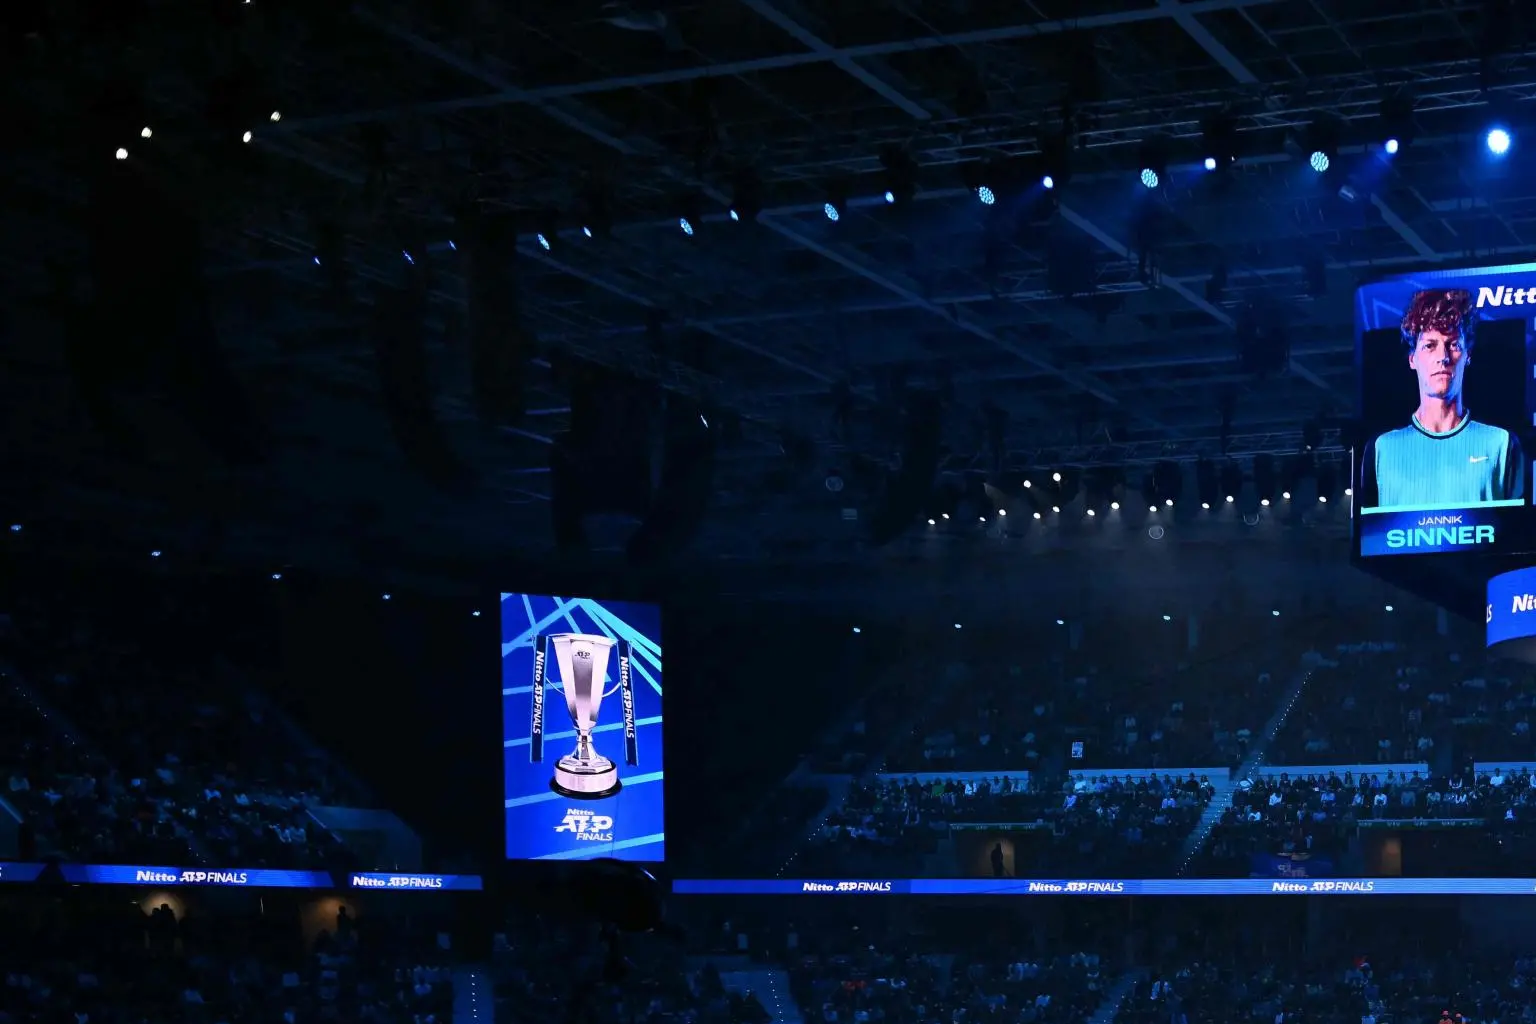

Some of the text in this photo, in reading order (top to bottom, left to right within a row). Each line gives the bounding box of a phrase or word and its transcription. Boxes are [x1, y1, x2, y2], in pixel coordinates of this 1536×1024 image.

[1418, 516, 1462, 525] JANNIK
[1386, 525, 1496, 548] SINNER
[535, 651, 544, 682] Nitto
[620, 656, 630, 686] Nitto
[533, 706, 542, 735] FINALS
[624, 707, 635, 739] FINALS
[566, 808, 595, 816] Nitto
[555, 815, 613, 833] ATP
[576, 833, 612, 842] FINALS
[137, 871, 246, 883] Nitto ATP FINALS
[353, 877, 441, 887] Nitto ATP FINALS
[836, 882, 856, 890] ATP
[858, 882, 891, 891] FINALS
[1029, 883, 1123, 891] Nitto ATP FINALS
[1273, 882, 1373, 891] Nitto ATP FINALS
